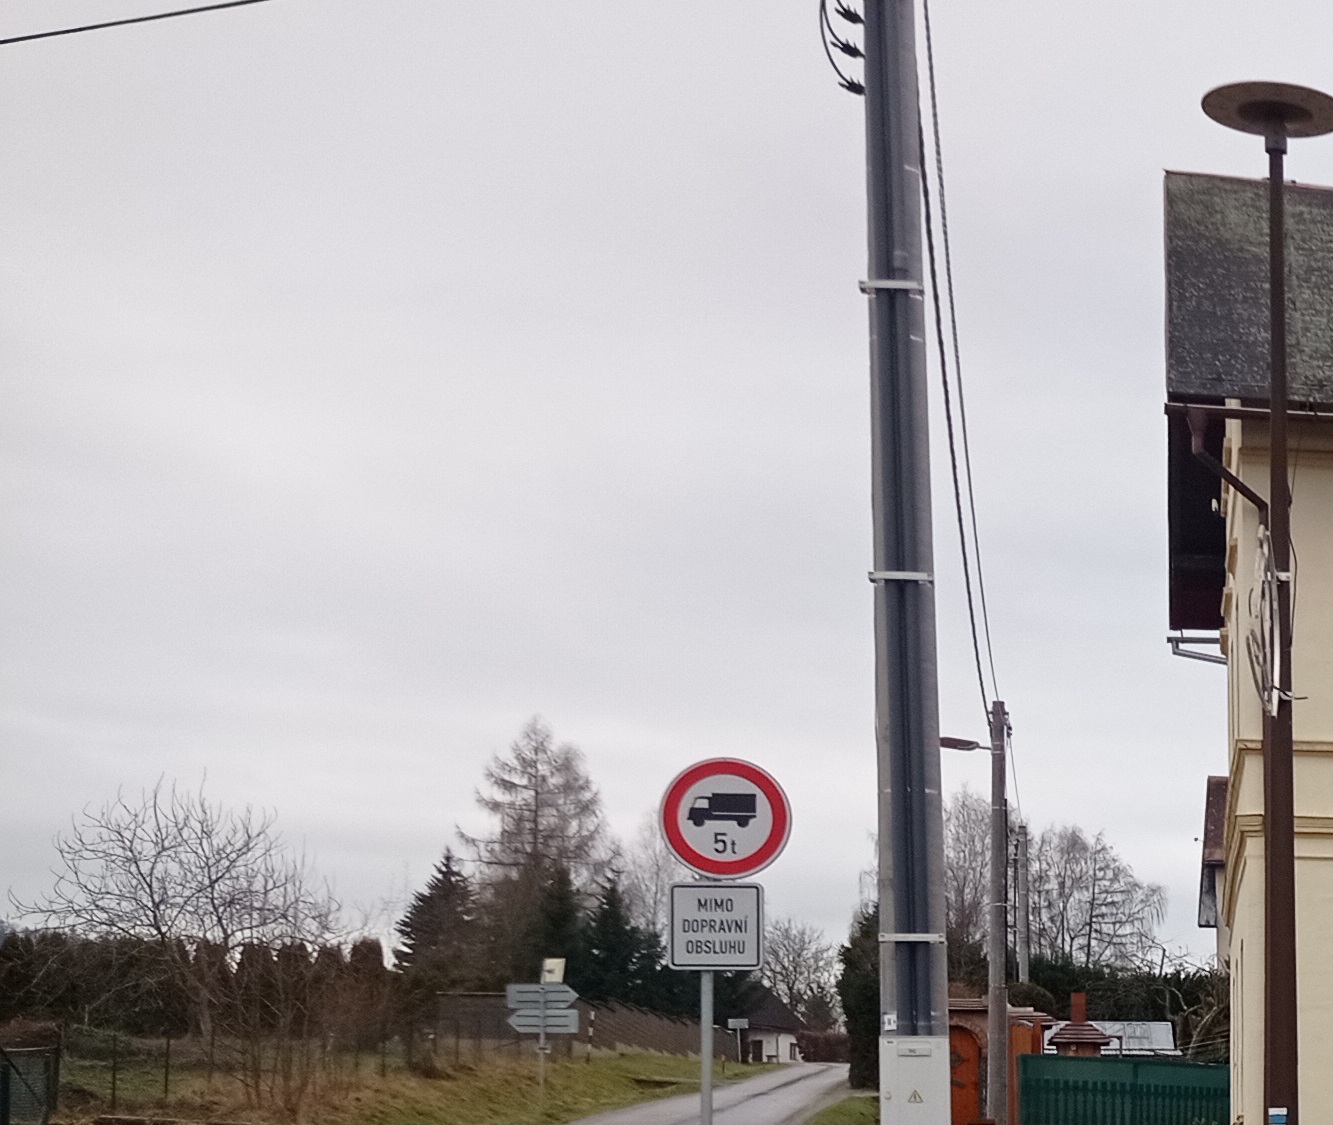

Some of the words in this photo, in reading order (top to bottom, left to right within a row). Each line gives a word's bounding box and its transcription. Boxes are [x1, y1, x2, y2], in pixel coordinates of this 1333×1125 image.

[697, 898, 733, 912] MIMO
[682, 916, 748, 934] DOPRAVNÍ
[686, 940, 745, 954] OBSLUHU
